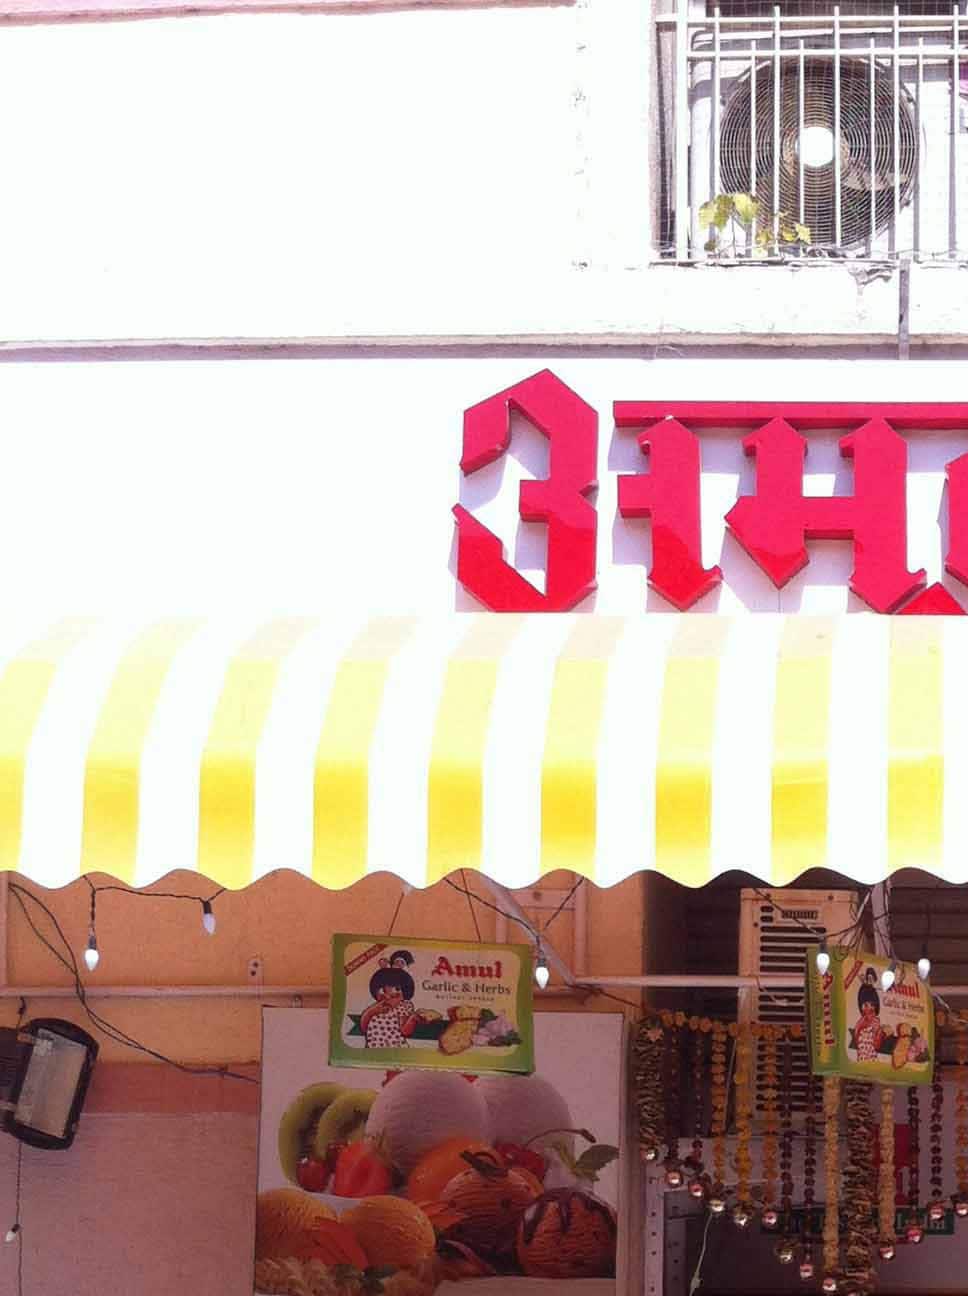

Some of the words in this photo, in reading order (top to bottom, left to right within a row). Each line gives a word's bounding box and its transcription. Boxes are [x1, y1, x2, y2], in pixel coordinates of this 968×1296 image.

[432, 956, 502, 979] Amul
[421, 979, 458, 993] Garlic
[462, 982, 473, 993] &
[475, 983, 511, 995] Herbs
